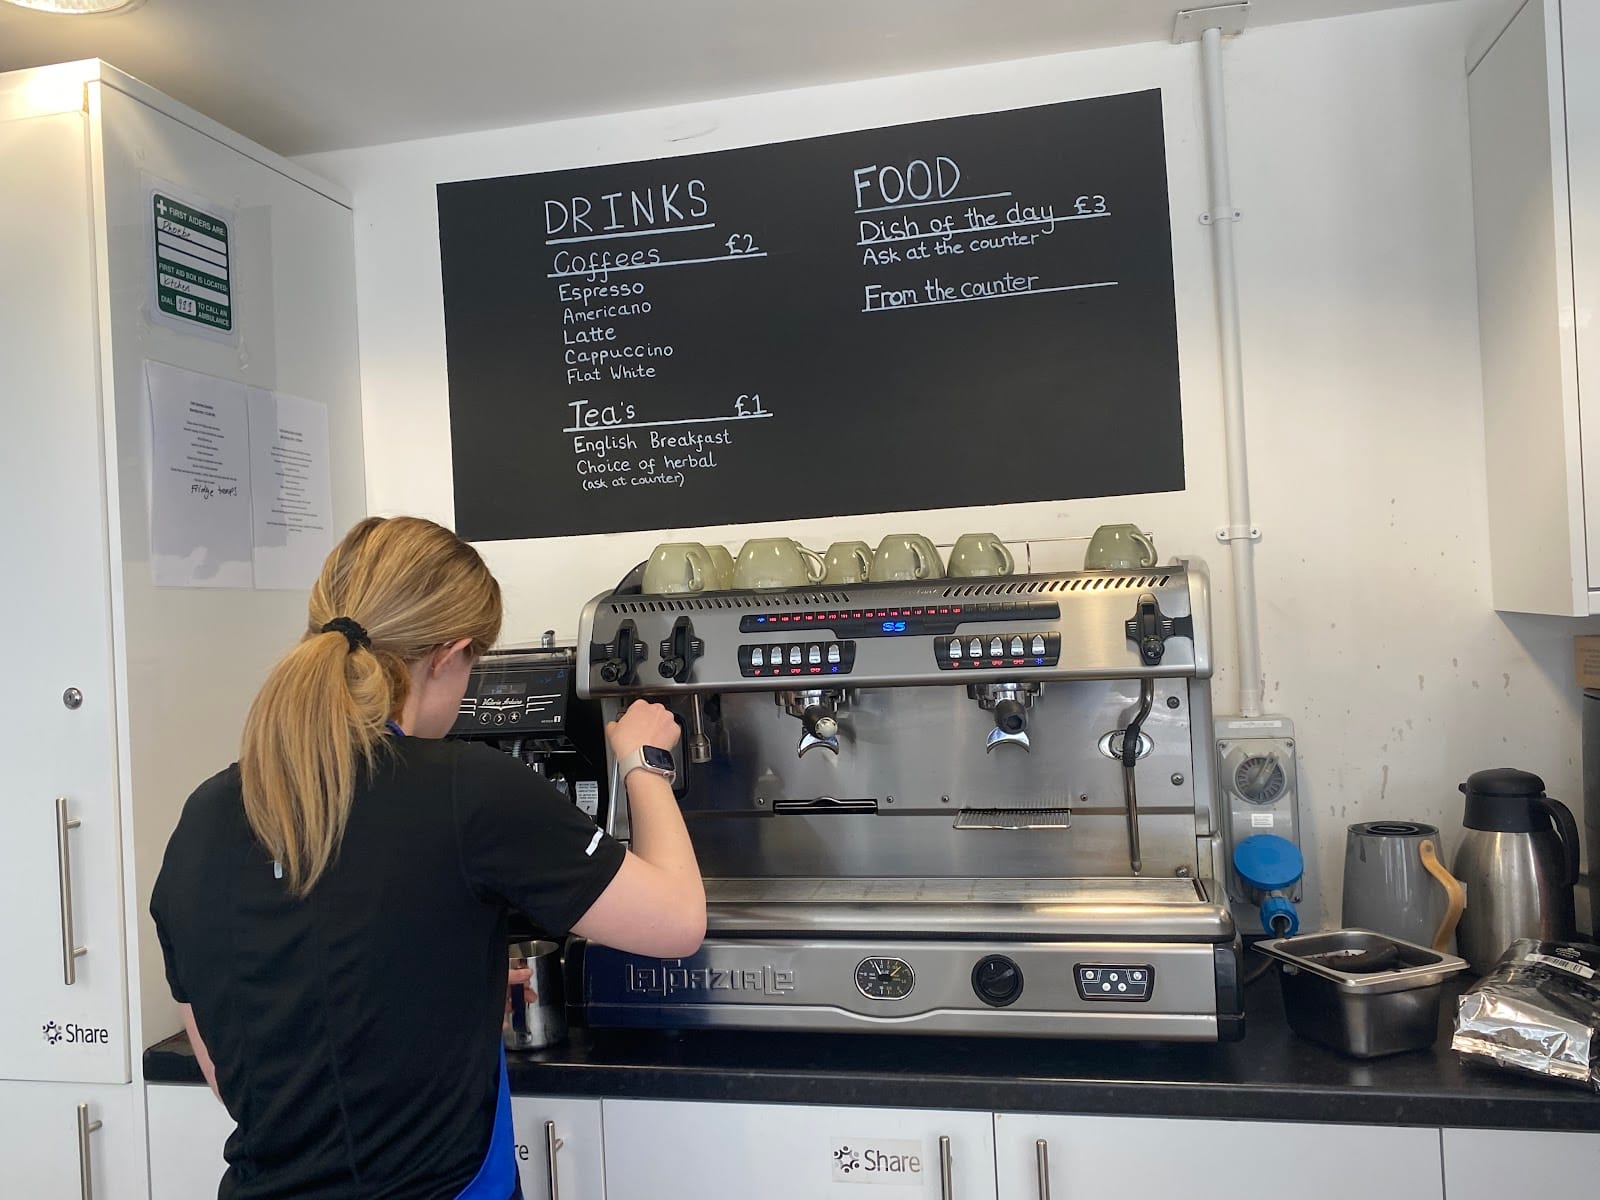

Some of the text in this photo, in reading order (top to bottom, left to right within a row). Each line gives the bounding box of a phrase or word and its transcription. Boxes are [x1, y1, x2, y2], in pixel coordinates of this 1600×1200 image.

[853, 156, 961, 208] FOOD
[169, 207, 187, 220] FIRST
[188, 215, 211, 231] AIDERS
[544, 180, 708, 234] DRINKS
[859, 195, 1106, 244] Dish of the day £3
[553, 233, 759, 282] Coffees £2
[863, 232, 1040, 266] Ask at the counter
[558, 281, 644, 306] Espresso
[864, 272, 1039, 310] From the counter
[563, 300, 652, 325] Americano
[563, 325, 617, 345] Latte
[564, 343, 674, 366] Cappuccino
[566, 364, 656, 384] Flat White
[568, 394, 767, 428] Tea's £1
[574, 429, 732, 457] English Breakfast
[577, 451, 717, 476] Choice of herbal
[582, 472, 685, 491] (ask at counter)
[65, 1023, 109, 1044] Share
[864, 1149, 921, 1173] Share
